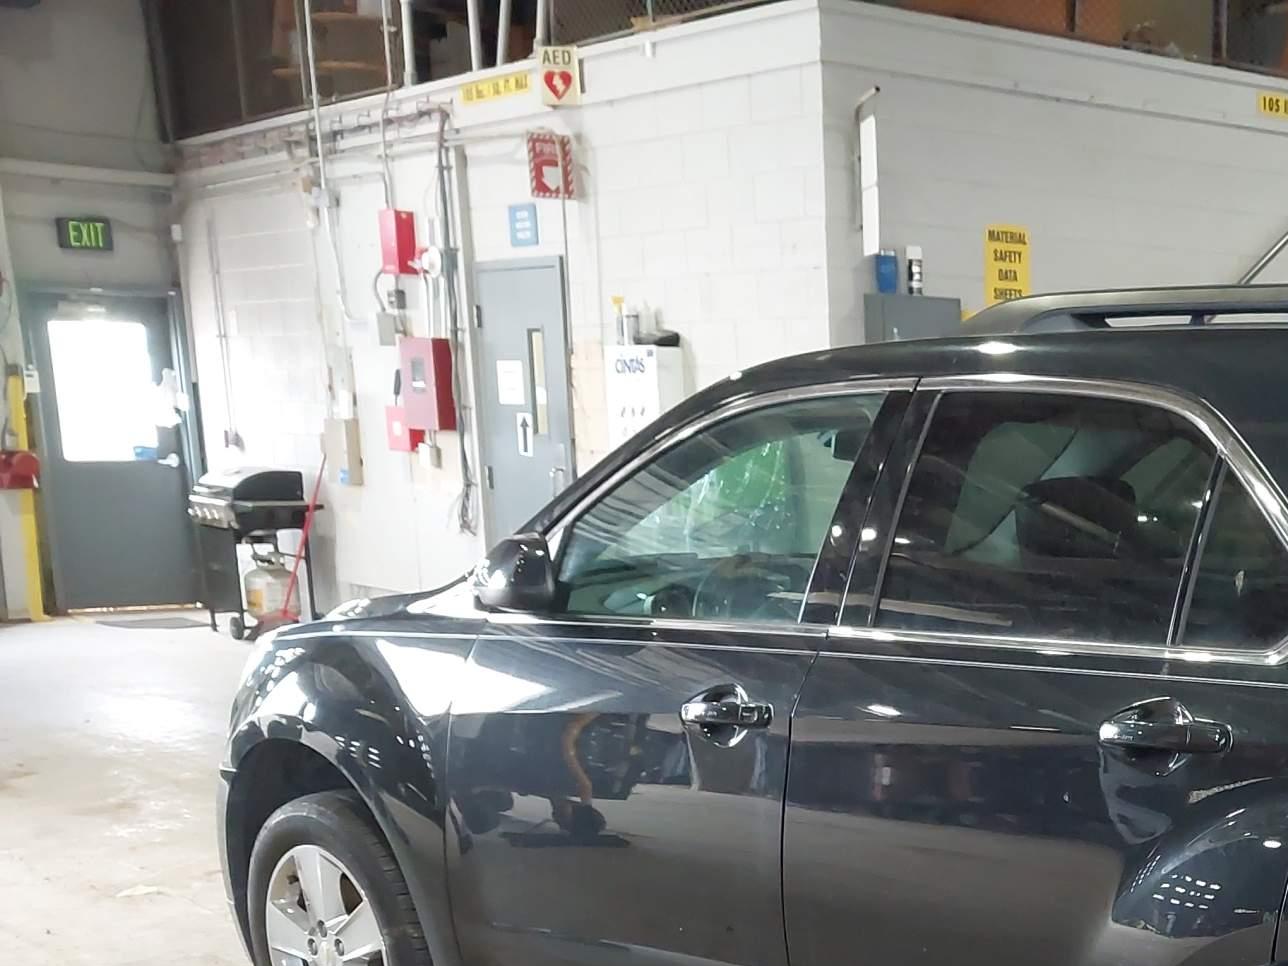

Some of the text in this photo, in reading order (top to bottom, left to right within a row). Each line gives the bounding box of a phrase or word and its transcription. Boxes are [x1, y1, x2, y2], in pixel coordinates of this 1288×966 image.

[542, 49, 571, 65] AED
[1262, 95, 1280, 113] 105
[68, 220, 105, 248] EXIT
[987, 229, 1027, 245] MATERIAL
[993, 248, 1022, 264] SAFETY
[998, 268, 1018, 282] DATA
